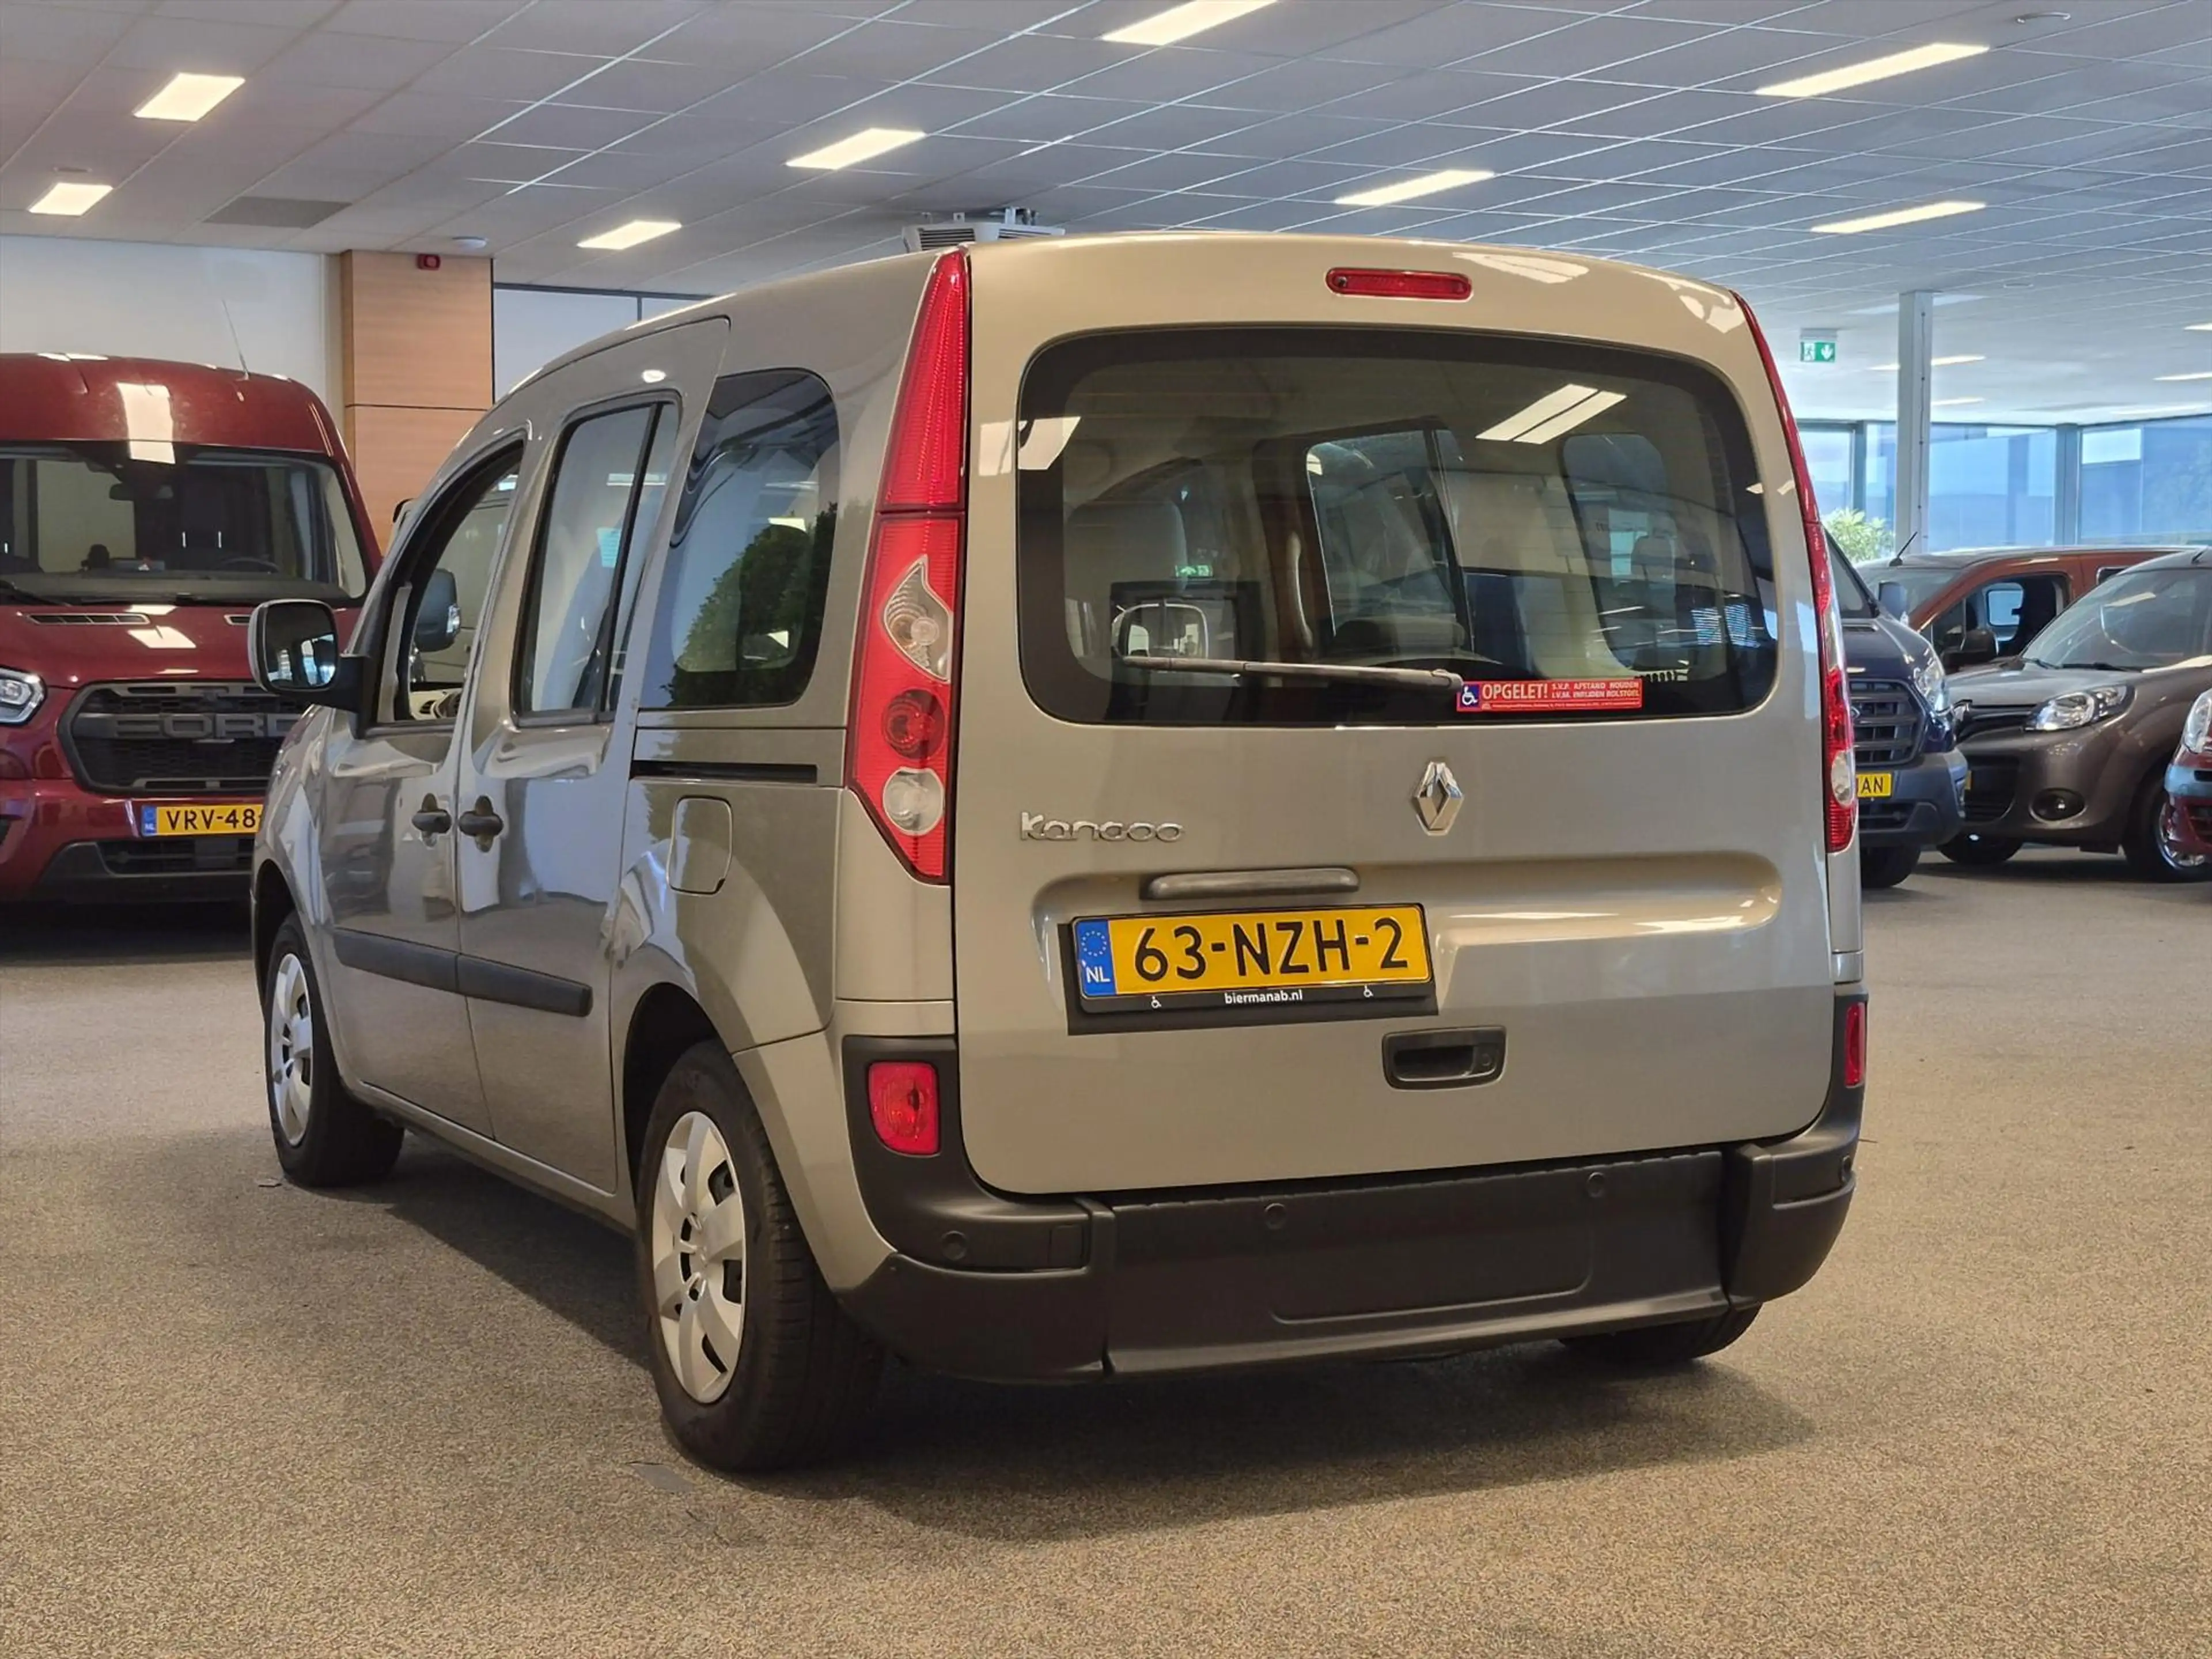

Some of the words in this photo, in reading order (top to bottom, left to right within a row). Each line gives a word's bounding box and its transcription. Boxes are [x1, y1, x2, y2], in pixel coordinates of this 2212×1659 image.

[1482, 684, 1548, 699] OPGELET!
[1855, 775, 1884, 794] AN
[1135, 917, 1408, 982] 63-NZH-2
[1086, 966, 1111, 983] NL
[1224, 988, 1303, 1004] biermanab.nl
